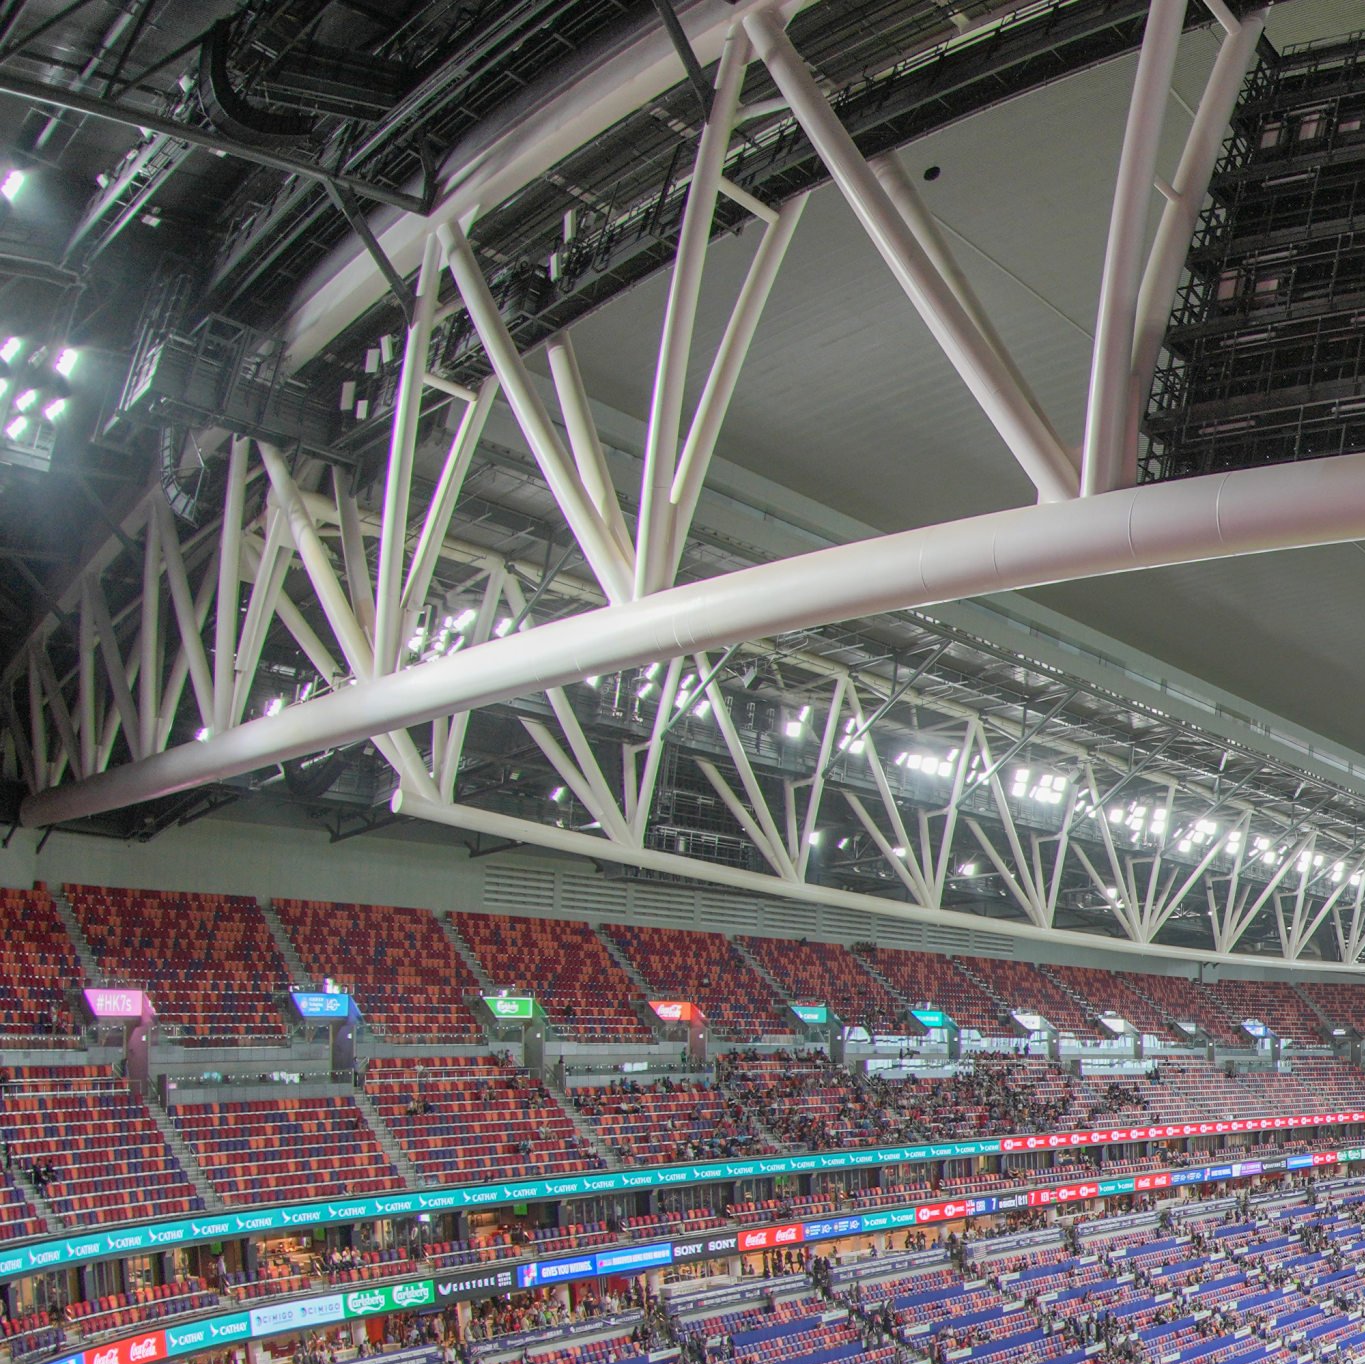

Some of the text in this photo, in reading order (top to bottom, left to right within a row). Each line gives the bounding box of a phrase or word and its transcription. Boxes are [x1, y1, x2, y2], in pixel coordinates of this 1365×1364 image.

[96, 994, 132, 1012] #HK7s
[656, 1004, 683, 1018] Coca-Cola
[701, 1169, 721, 1178] CATHAY
[734, 1166, 754, 1175] CATHAY
[767, 1163, 786, 1172] CATHAY
[629, 1176, 652, 1185] CATHAY
[665, 1172, 687, 1182] CATHAY
[554, 1183, 578, 1194] CATHAY
[592, 1179, 615, 1190] CATHAY
[472, 1192, 498, 1202] CATHAY
[513, 1188, 538, 1198] CATHAY
[383, 1201, 412, 1212] CATHAY
[428, 1197, 455, 1208] CATHAY
[292, 1210, 321, 1222] CATHAY
[338, 1206, 366, 1218] CATHAY
[201, 1223, 229, 1235] CATHAY
[246, 1217, 273, 1229] CATHAY
[158, 1229, 184, 1242] CATHAY
[745, 1228, 797, 1246] Coca-Cola Coca-Cola
[115, 1236, 142, 1249] CATHAY
[674, 1239, 736, 1256] SONY SONY
[74, 1243, 100, 1256] CATHAY
[37, 1250, 60, 1264] CATHAY
[542, 1265, 558, 1278] GIVES
[558, 1264, 570, 1276] YOU
[452, 1276, 495, 1292] CASTORE
[347, 1282, 429, 1314] Carlsberg Carlsberg
[263, 1303, 340, 1325] CIMIGO CIMIGO
[179, 1322, 248, 1345] CATHAY CATHAY
[130, 1338, 157, 1362] Coca-Cola
